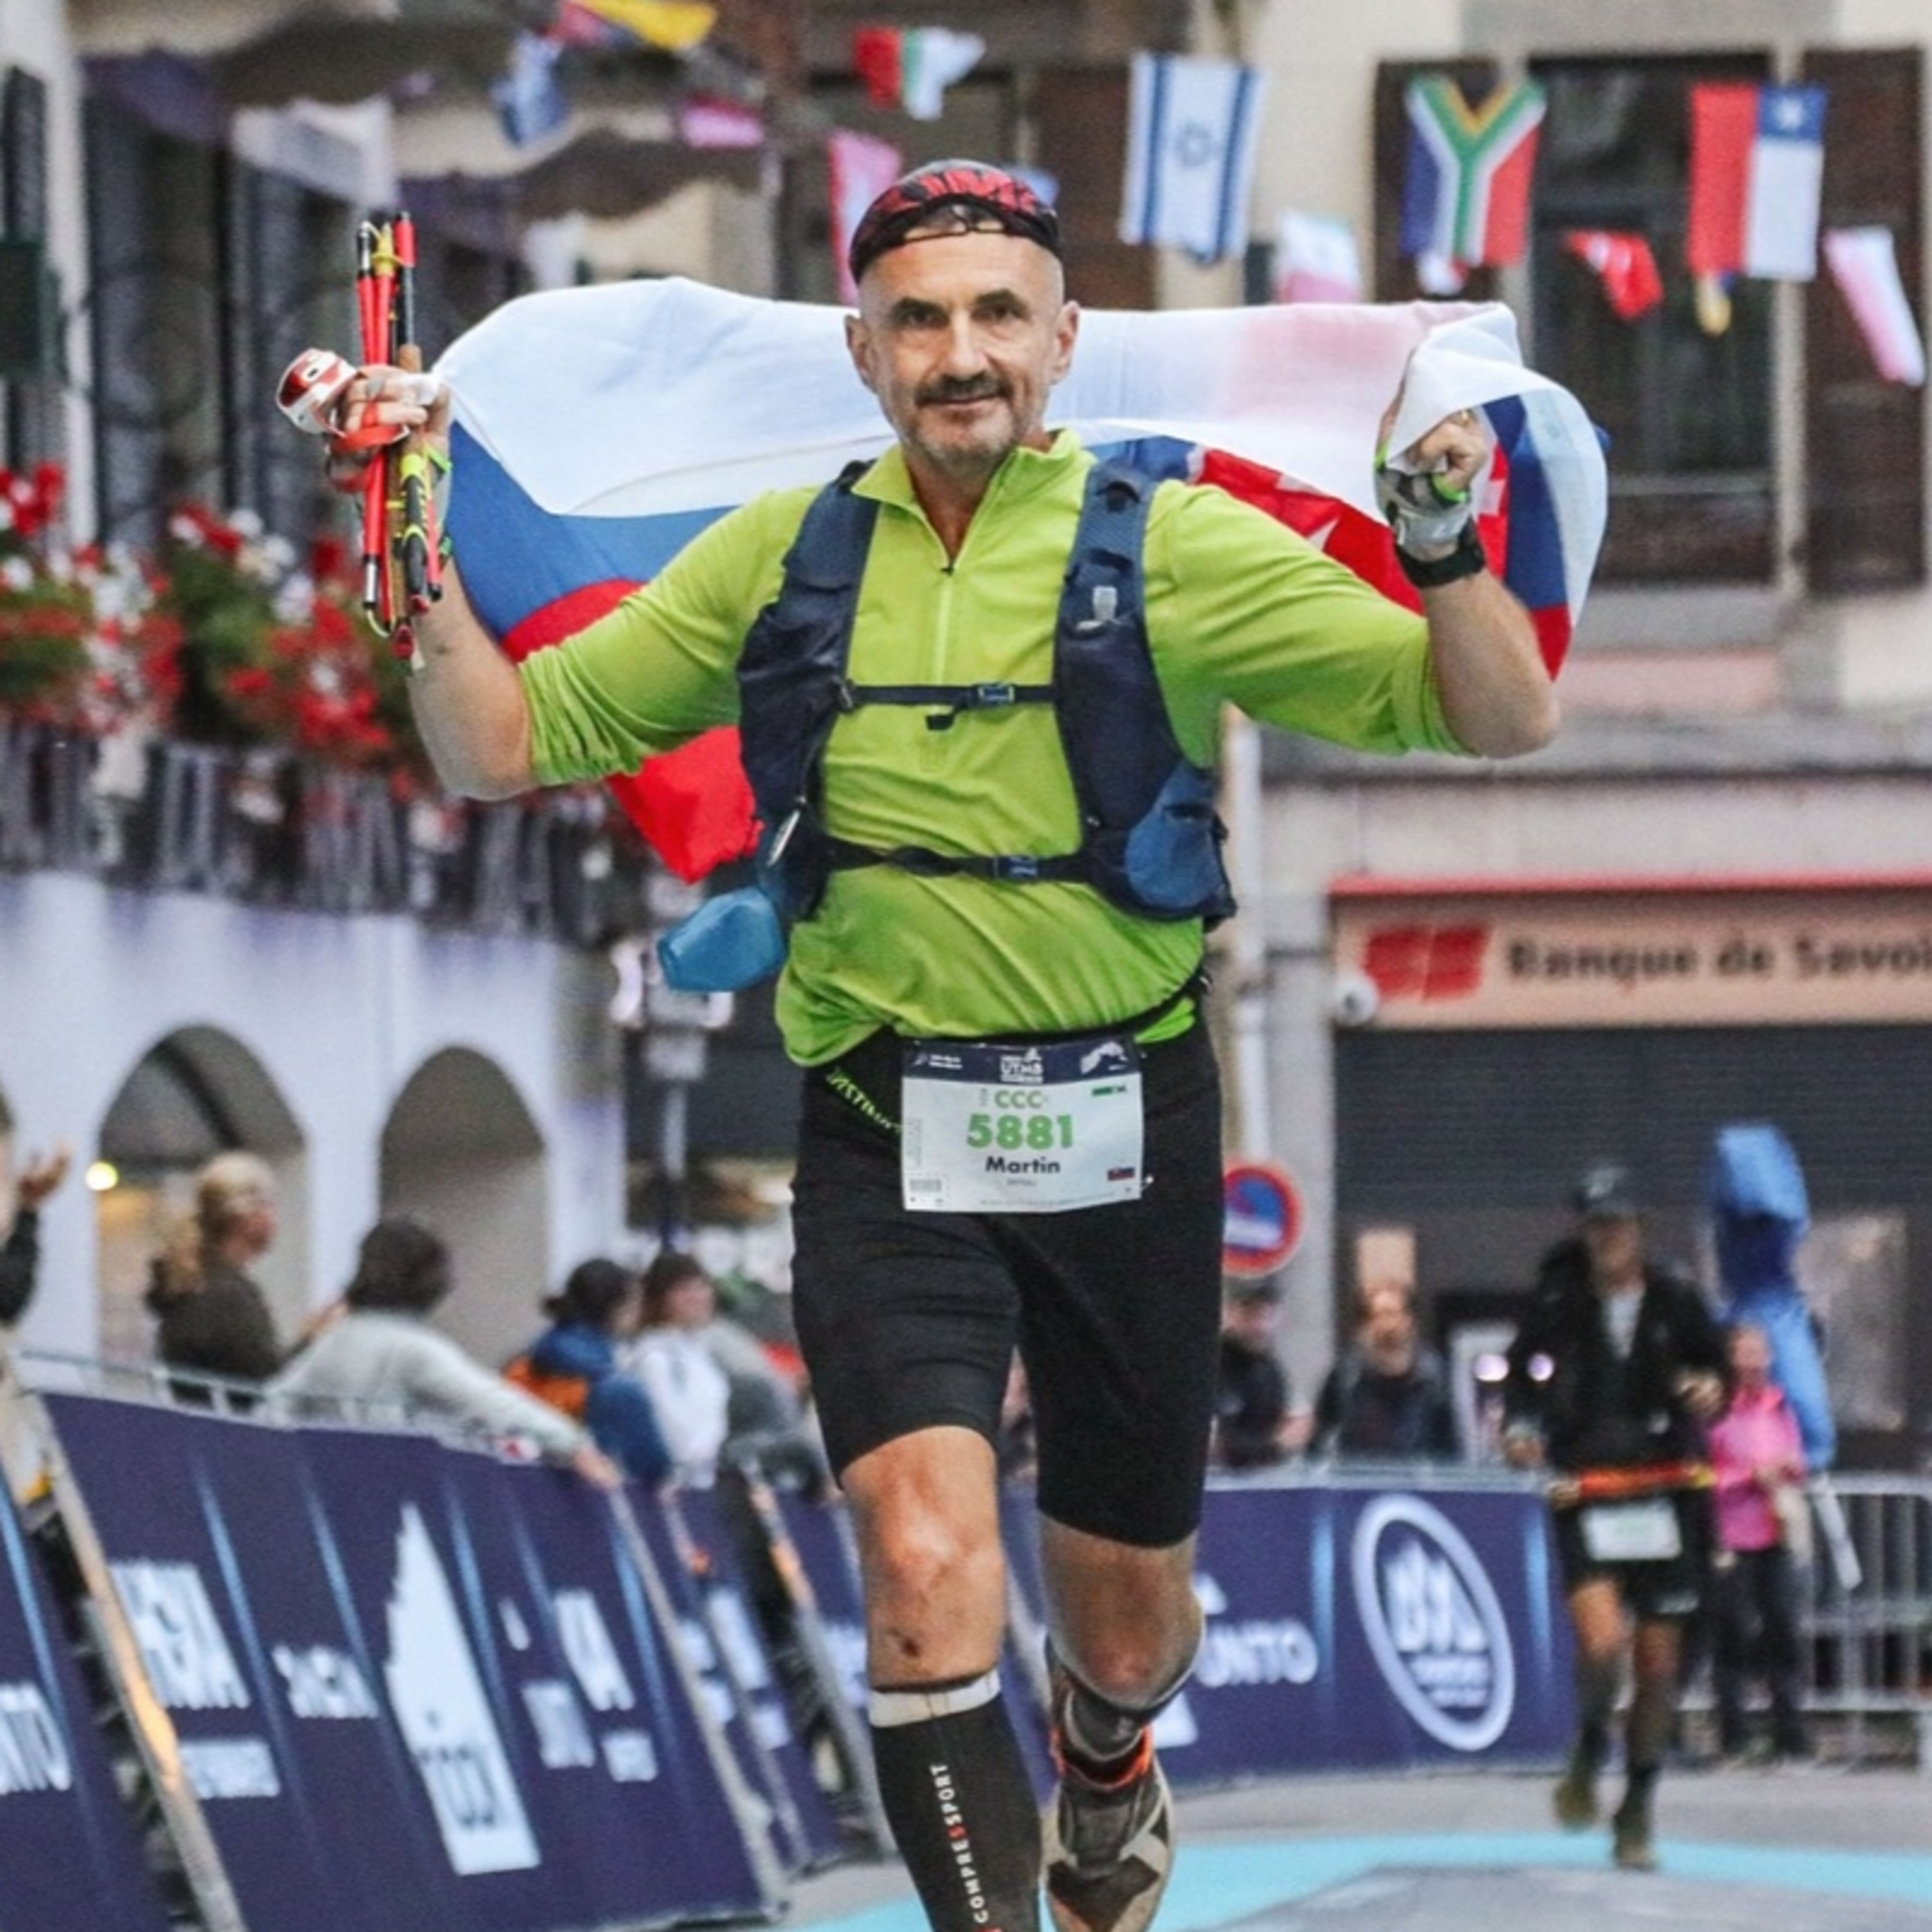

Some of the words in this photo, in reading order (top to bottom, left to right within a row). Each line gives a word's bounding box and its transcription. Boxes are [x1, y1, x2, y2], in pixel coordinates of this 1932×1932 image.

[1509, 938, 1695, 992] Banque
[1717, 929, 1775, 978] de
[995, 1090, 1043, 1108] CCC
[967, 1113, 1074, 1150] 5881
[985, 1156, 1061, 1174] Martin
[929, 1764, 989, 1924] COMPRESSPORT
